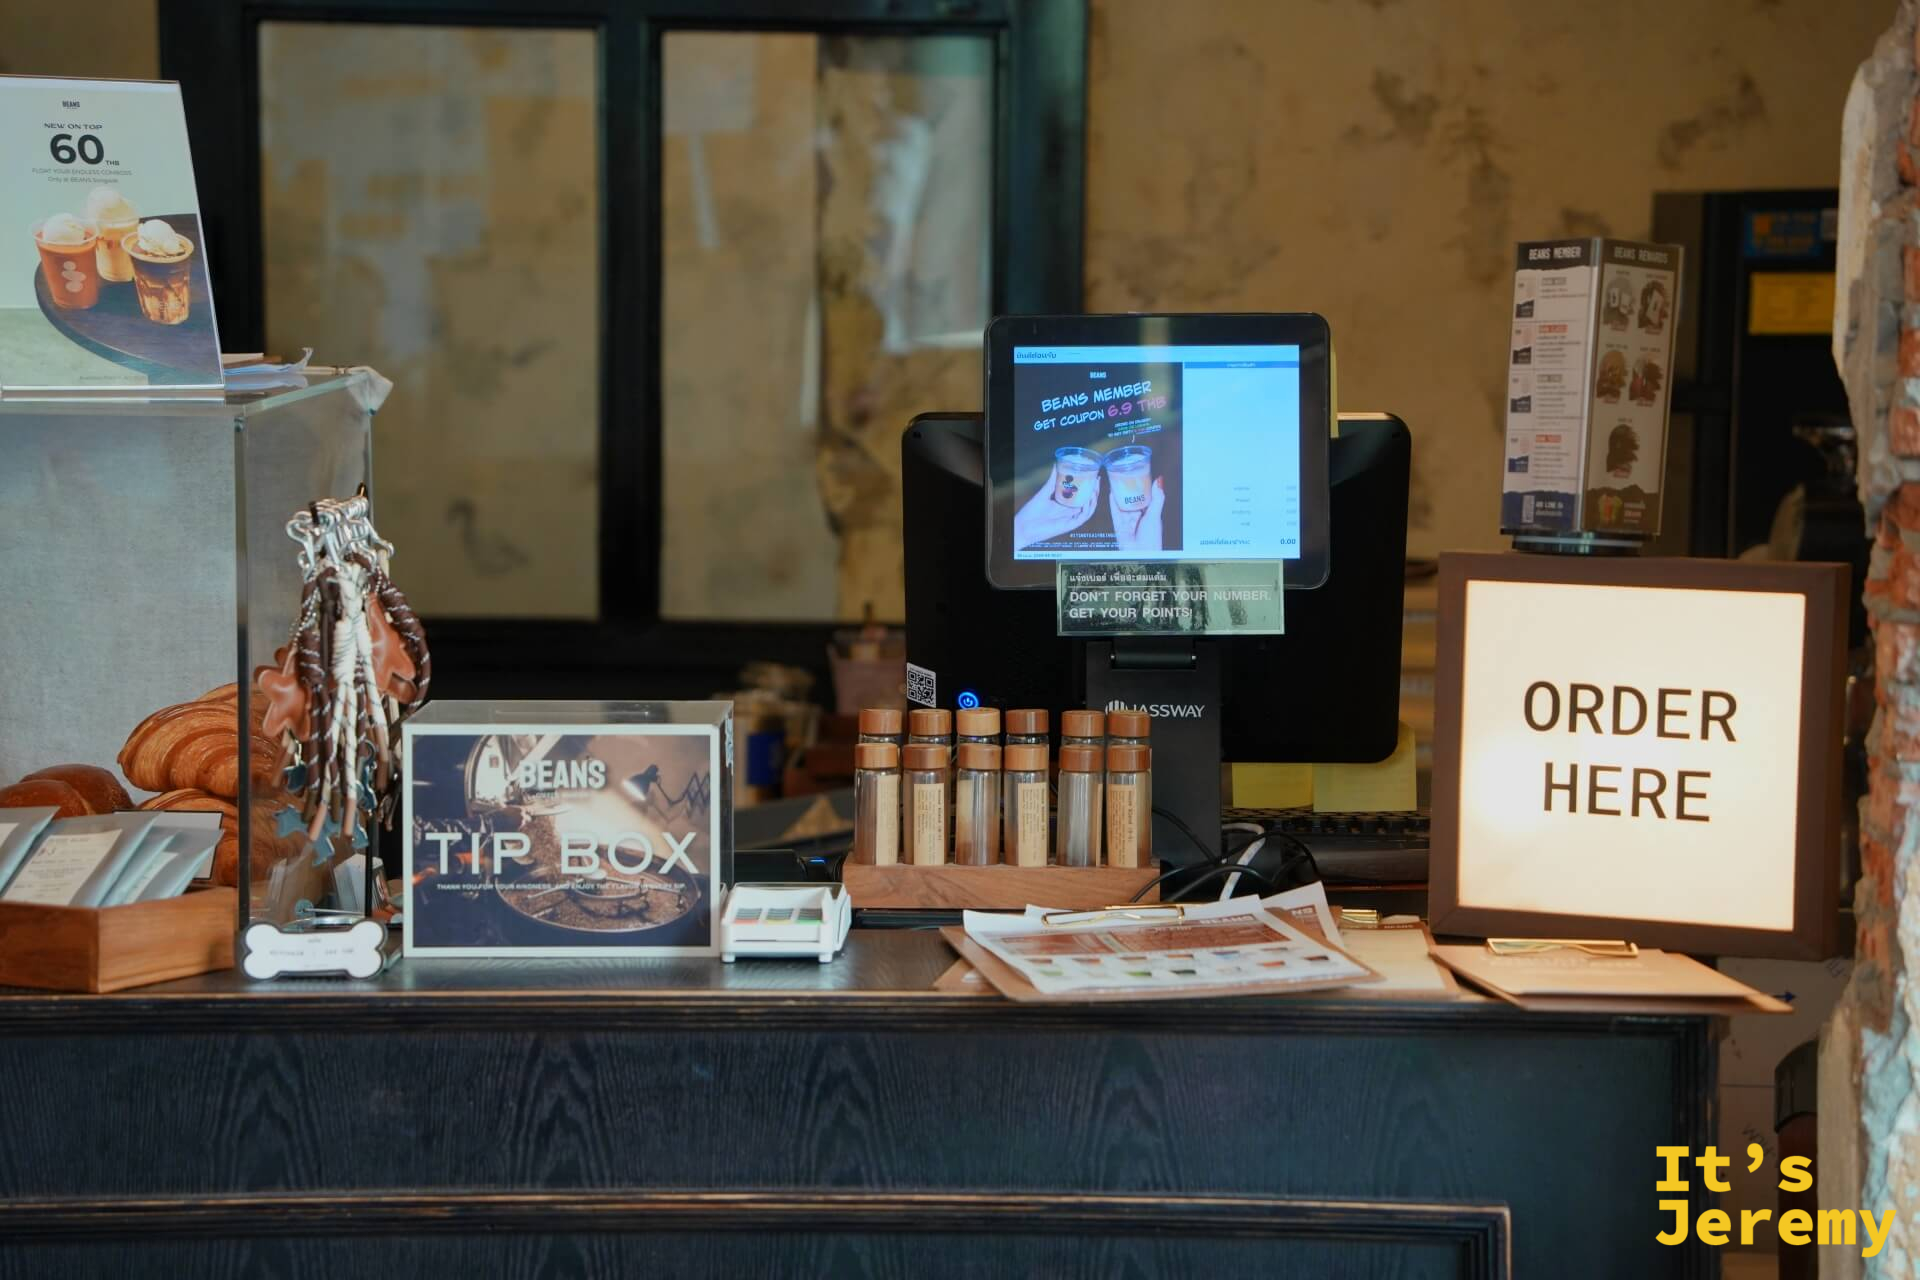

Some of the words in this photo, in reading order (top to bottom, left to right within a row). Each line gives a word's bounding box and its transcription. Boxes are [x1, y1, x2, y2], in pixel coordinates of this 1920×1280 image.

[62, 100, 80, 108] BEANS
[50, 133, 104, 165] 60
[1528, 248, 1551, 260] BEANS
[1614, 247, 1635, 260] BEANS
[1041, 393, 1088, 413] BEANS
[1093, 381, 1152, 403] MEMBER
[1034, 418, 1057, 431] GET
[1060, 410, 1105, 426] COUPON
[1107, 402, 1132, 417] 6.9
[1137, 397, 1168, 412] THB
[1069, 591, 1109, 602] DON'T
[1115, 591, 1166, 602] FORGET
[1172, 591, 1208, 601] YOUR
[1213, 590, 1271, 601] NUMBER.
[1069, 607, 1094, 618] GET
[1100, 607, 1136, 618] YOUR
[1142, 607, 1193, 618] POINTS!
[1523, 680, 1738, 742] ORDER
[518, 759, 607, 790] BEANS
[1542, 762, 1712, 823] HERE
[425, 832, 531, 875] TIP
[560, 831, 700, 875] BOX
